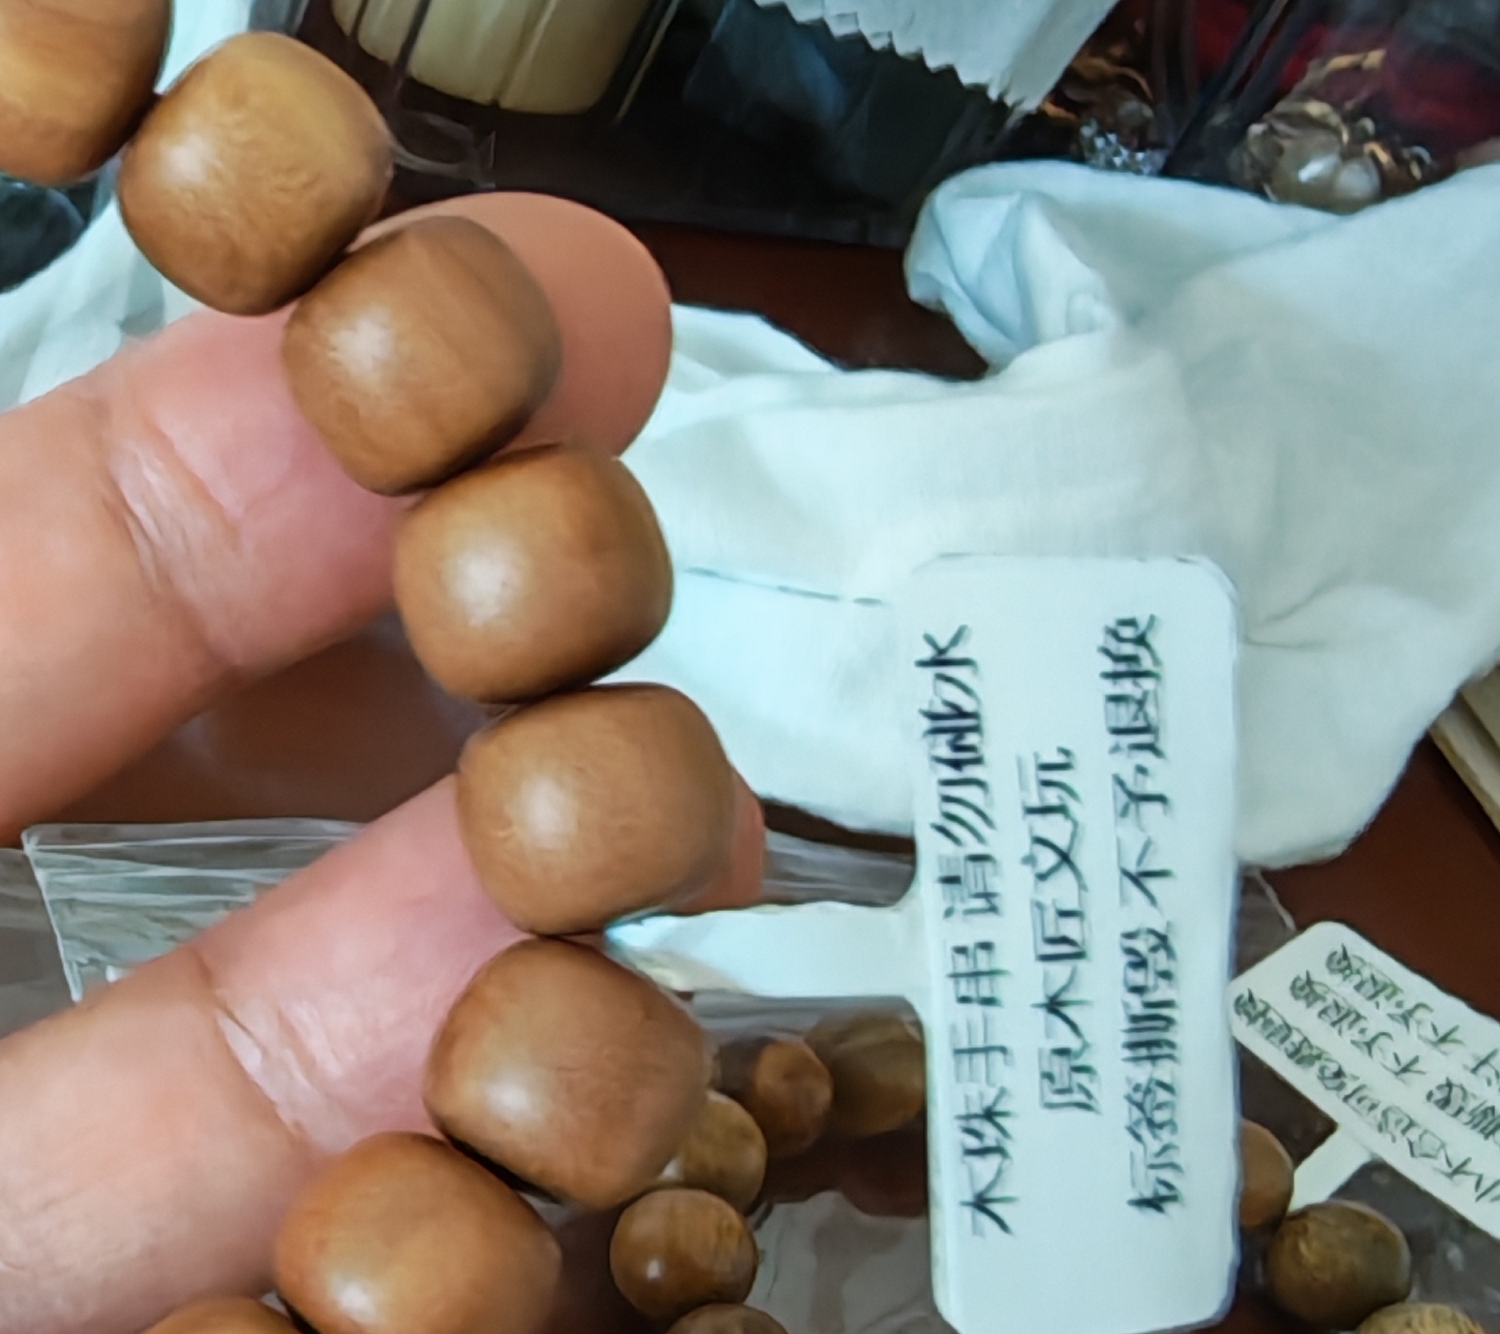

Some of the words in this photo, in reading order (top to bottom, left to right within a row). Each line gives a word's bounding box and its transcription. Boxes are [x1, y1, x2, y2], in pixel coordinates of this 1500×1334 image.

[1018, 746, 1099, 1115] 原木匠文玩
